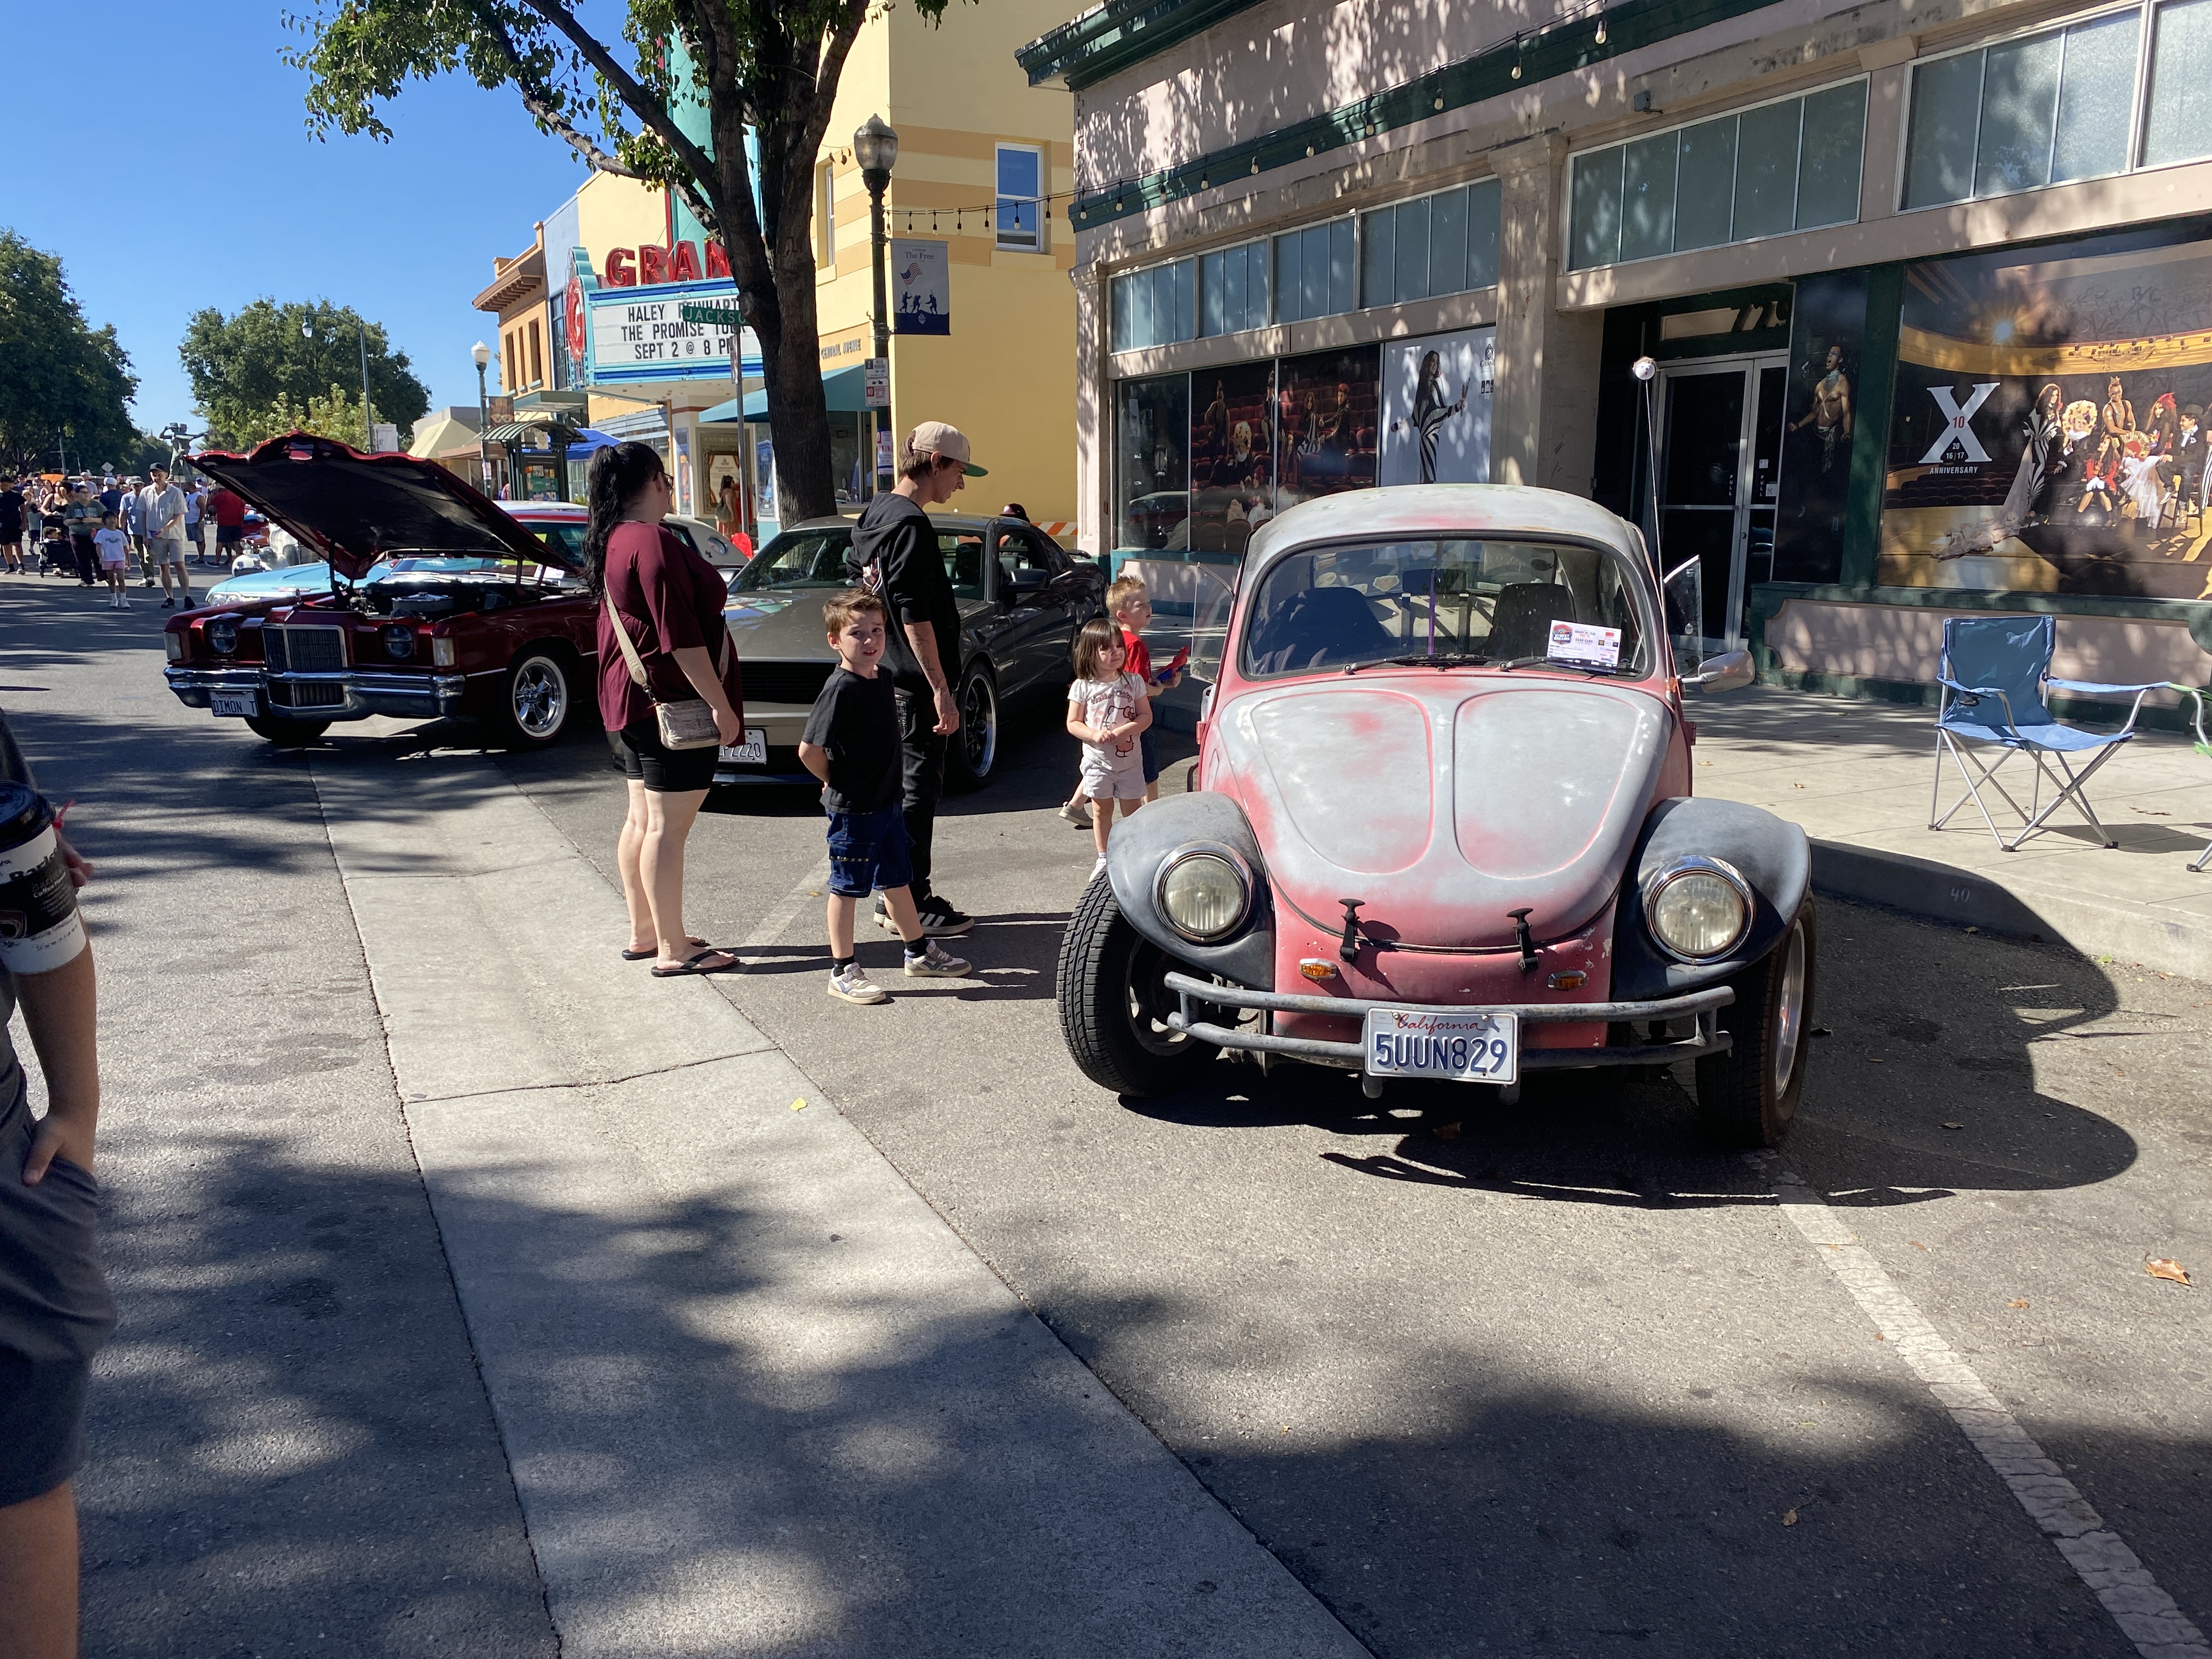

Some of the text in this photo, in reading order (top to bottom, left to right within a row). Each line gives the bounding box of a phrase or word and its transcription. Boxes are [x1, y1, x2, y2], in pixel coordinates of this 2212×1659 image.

[605, 240, 732, 288] GRAN
[628, 303, 665, 323] HALEY
[685, 308, 747, 324] JACKSO
[621, 321, 746, 342] THE PROMISE TOU
[635, 342, 663, 359] SEPT
[672, 341, 679, 357] 2
[686, 341, 694, 354] @
[703, 339, 710, 356] 8
[843, 338, 861, 354] AVENUE
[868, 360, 872, 369] 2
[1918, 382, 2001, 464] X
[1953, 416, 1965, 428] 10
[1929, 466, 1978, 475] ANNIVERSARY
[212, 700, 255, 714] DIMON T
[1950, 887, 1971, 903] 40
[1397, 1013, 1489, 1035] California
[1375, 1033, 1508, 1074] 5UUN829
